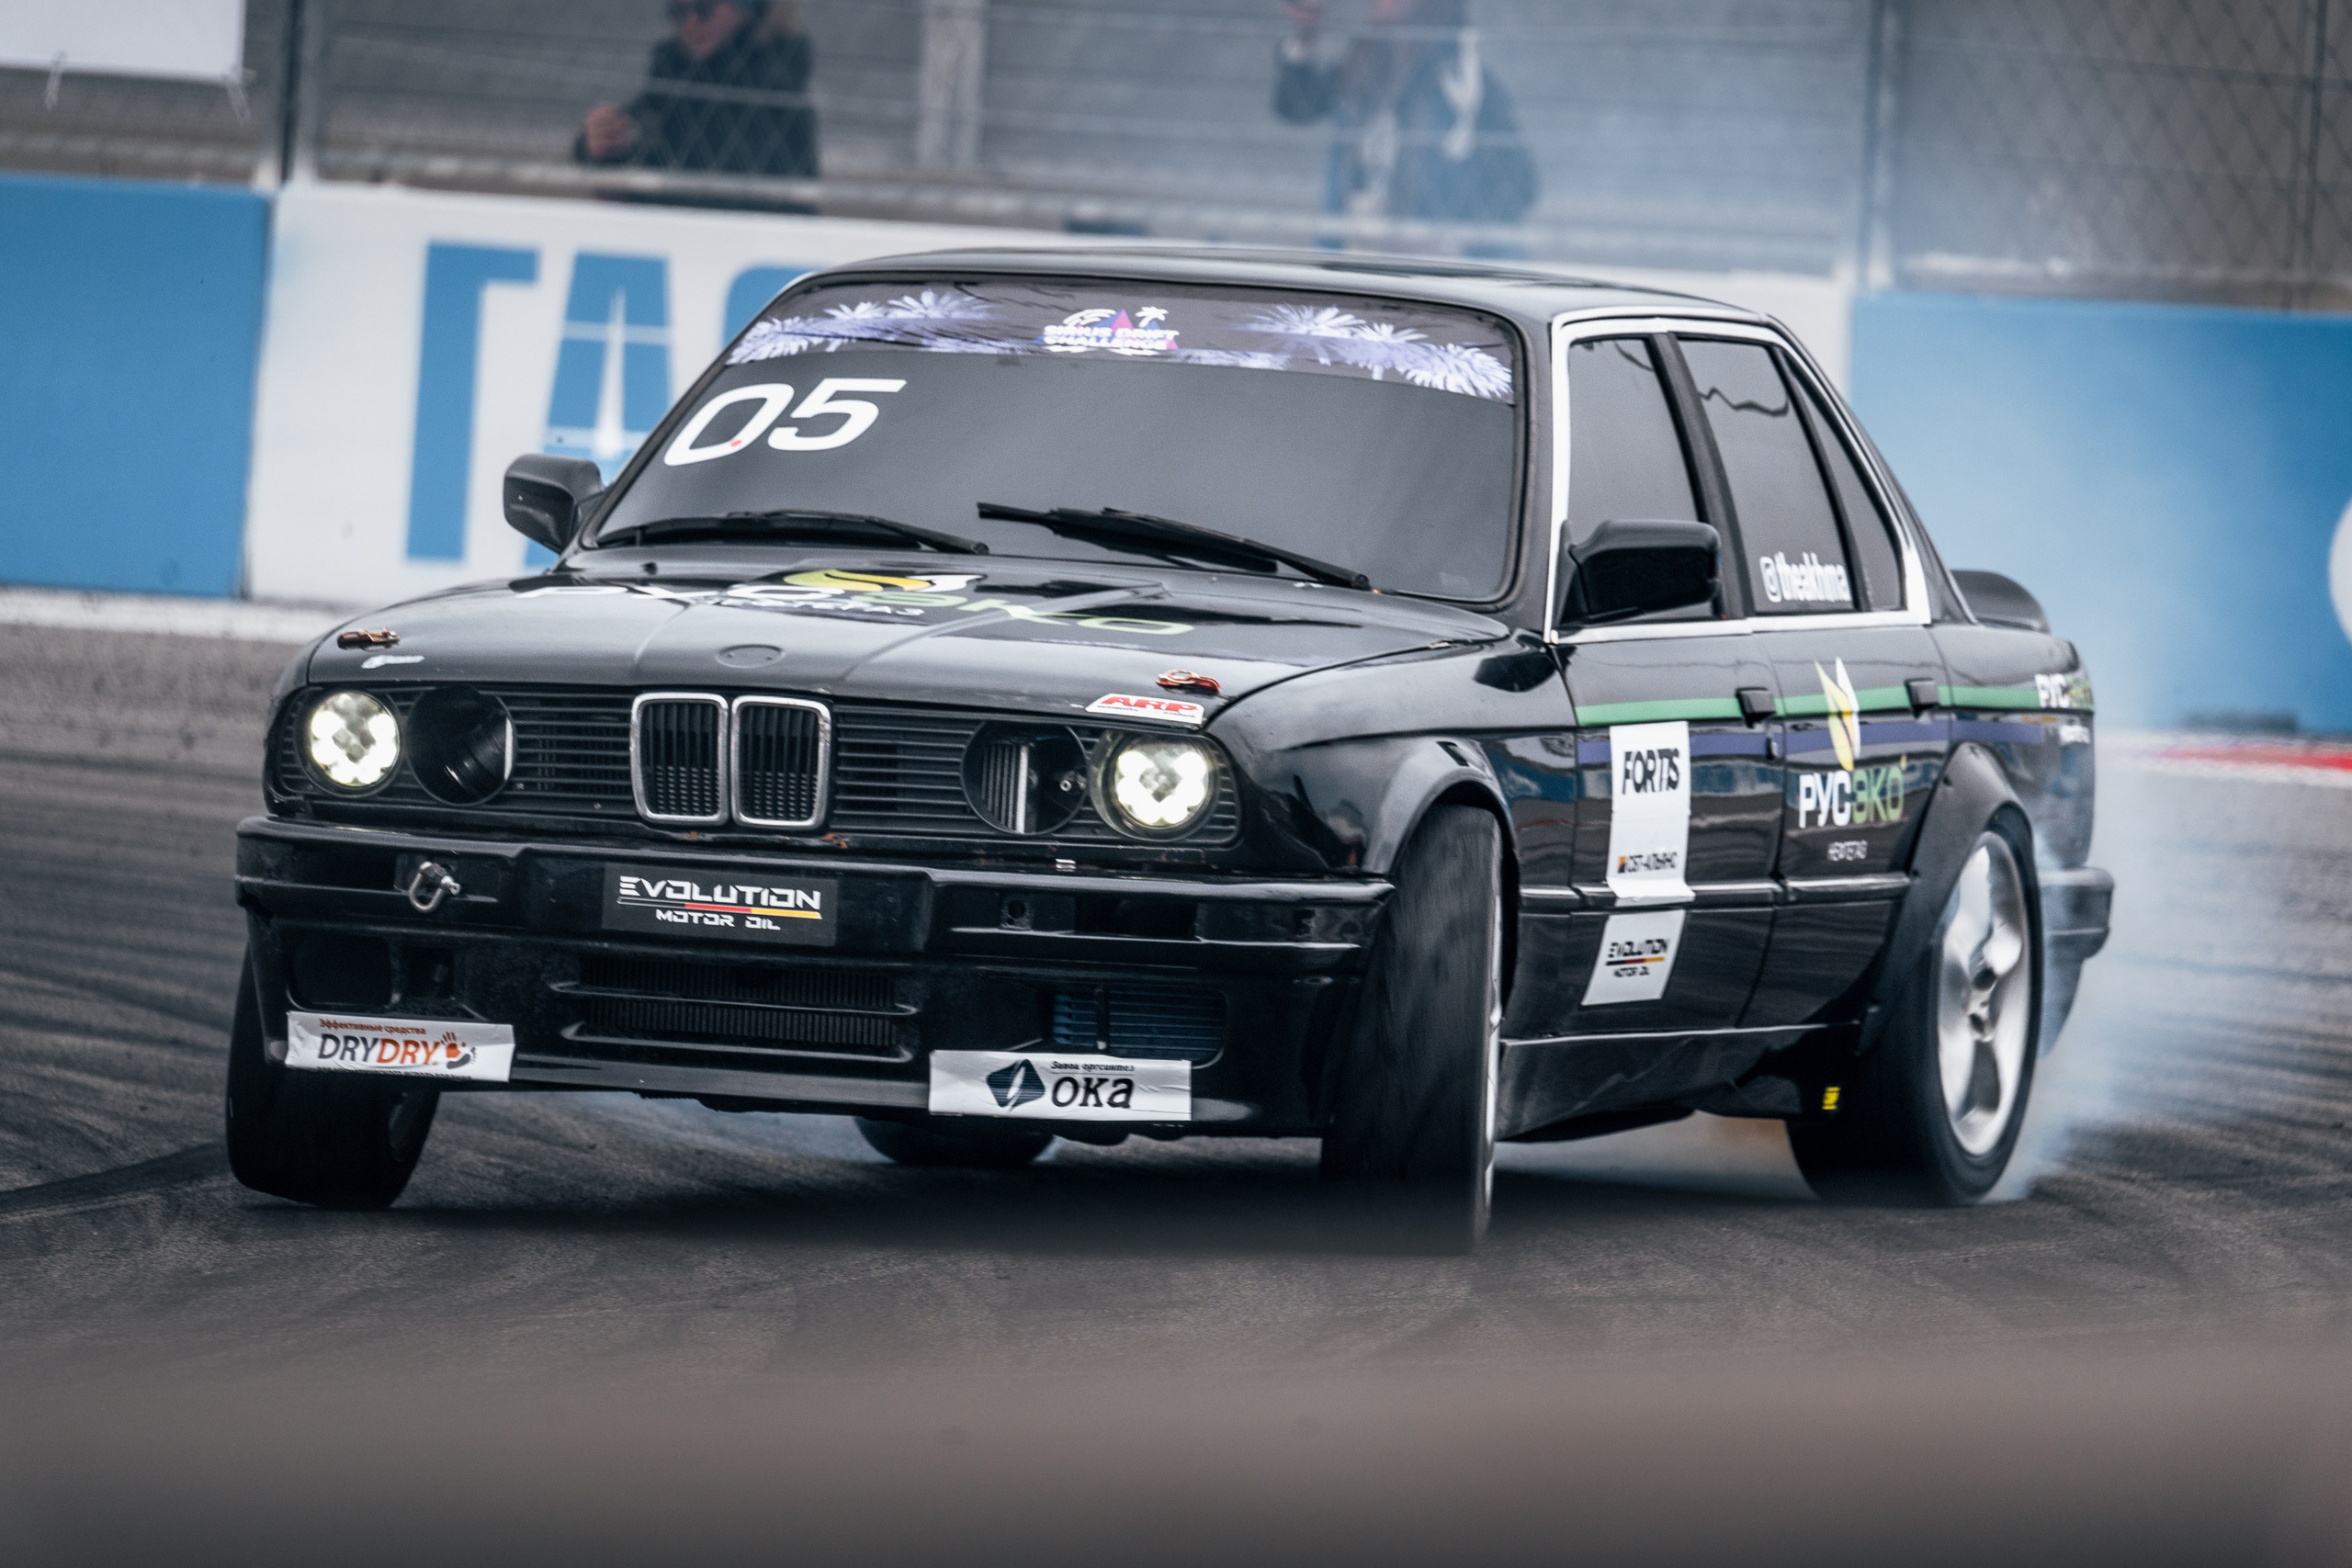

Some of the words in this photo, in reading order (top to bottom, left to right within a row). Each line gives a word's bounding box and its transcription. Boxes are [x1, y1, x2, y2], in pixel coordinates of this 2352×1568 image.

[663, 378, 908, 467] 05
[1102, 696, 1197, 712] ARP
[1799, 770, 1905, 829] РУСЭКО
[619, 875, 821, 910] EVOLUTION
[655, 908, 736, 928] MOTOR
[744, 916, 781, 931] OIL
[1608, 938, 1671, 958] EVOLUTION
[319, 1018, 383, 1034] Эффективные
[383, 1024, 427, 1036] средства
[1051, 1061, 1080, 1070] Завод
